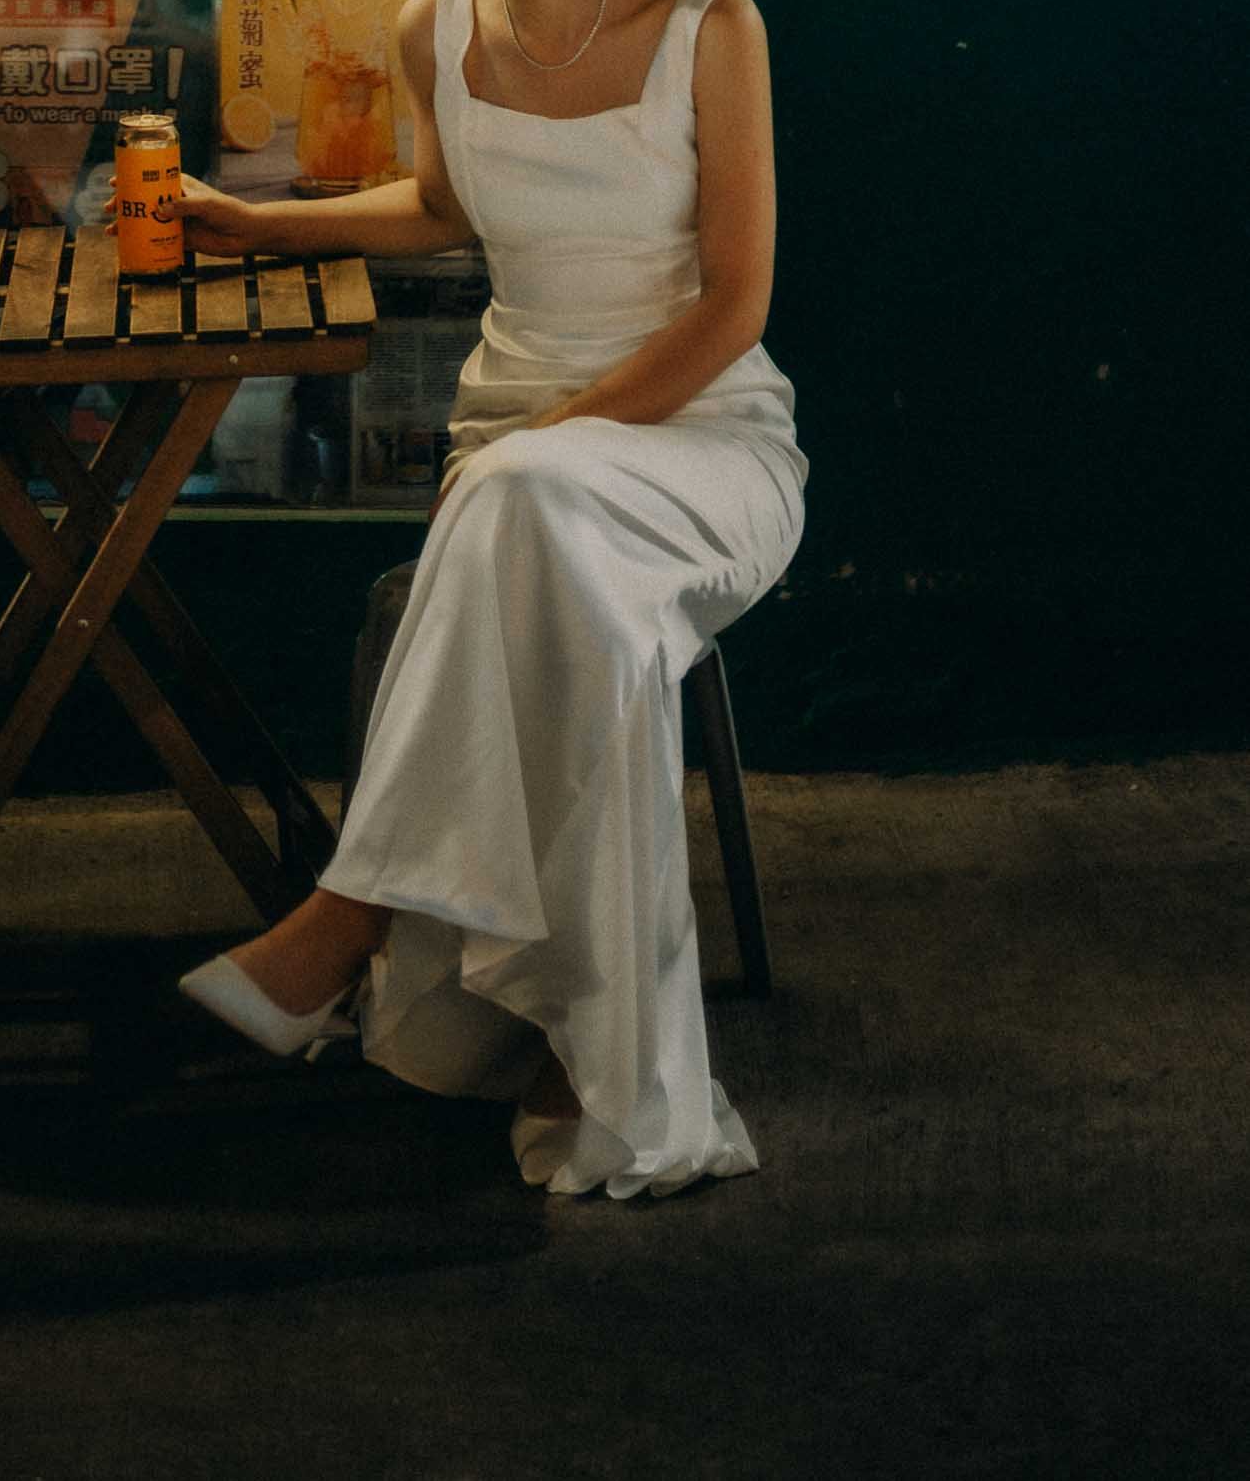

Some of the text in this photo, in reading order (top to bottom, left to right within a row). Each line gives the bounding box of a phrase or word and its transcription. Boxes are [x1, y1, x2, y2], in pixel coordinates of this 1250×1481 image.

[4, 105, 25, 124] to
[29, 107, 80, 124] wear
[84, 107, 99, 124] a
